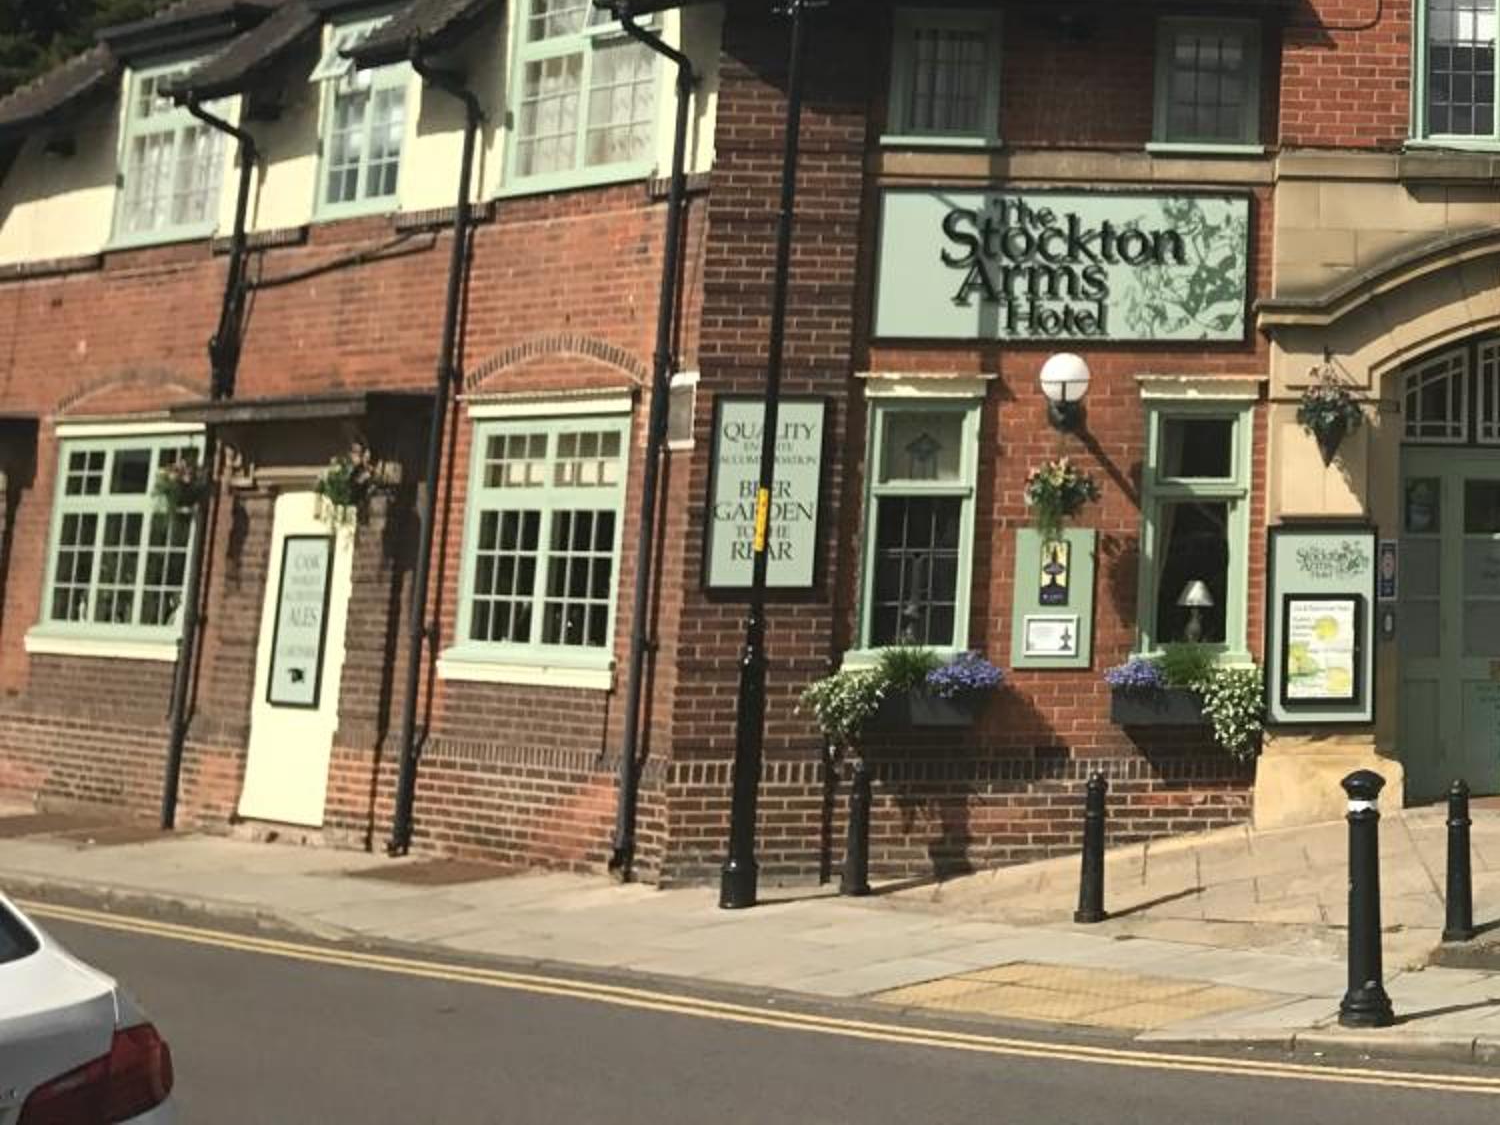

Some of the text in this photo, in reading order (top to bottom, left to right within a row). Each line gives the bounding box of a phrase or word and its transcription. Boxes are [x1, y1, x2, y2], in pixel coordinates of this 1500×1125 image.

[994, 197, 1055, 229] The
[940, 208, 1187, 268] Stockton
[952, 258, 1110, 306] Arms
[1004, 300, 1110, 337] Hotel
[723, 421, 816, 442] QUITY
[739, 480, 791, 498] BER
[712, 501, 814, 521] GADEN
